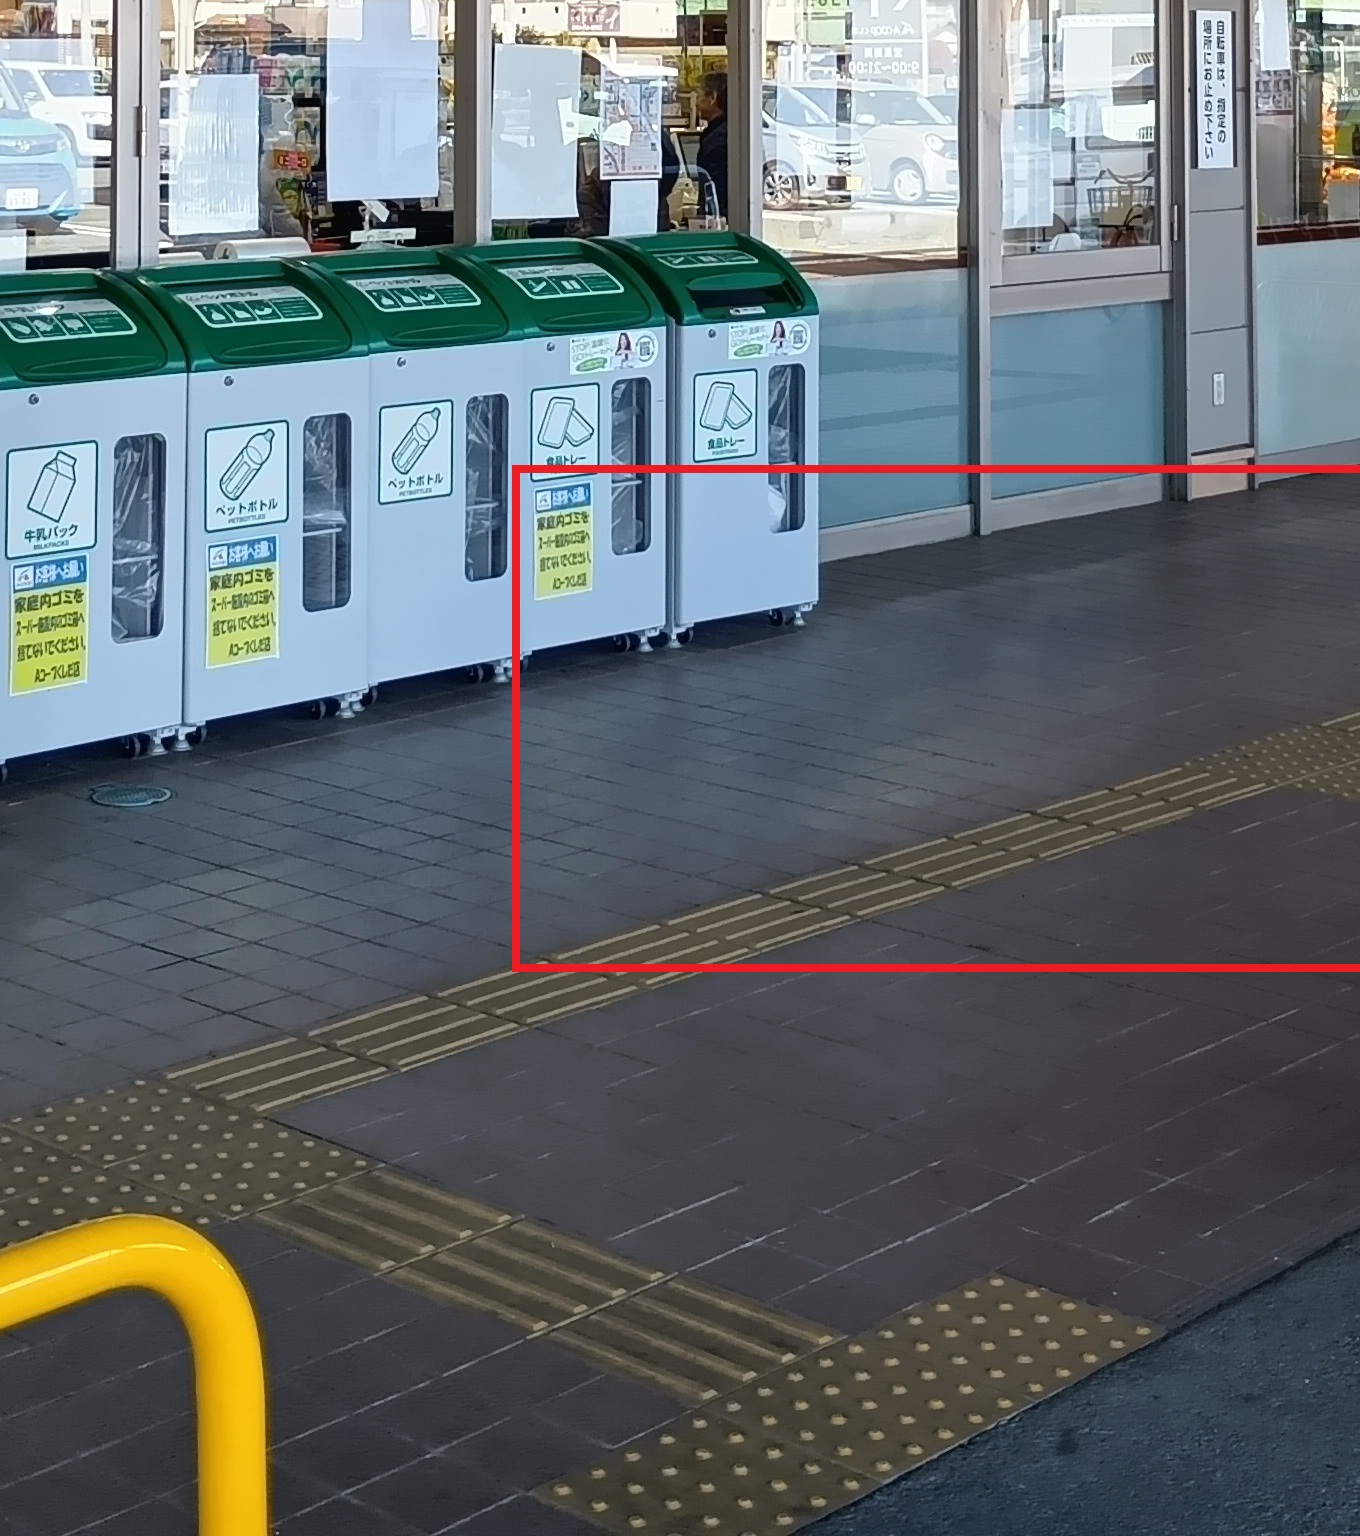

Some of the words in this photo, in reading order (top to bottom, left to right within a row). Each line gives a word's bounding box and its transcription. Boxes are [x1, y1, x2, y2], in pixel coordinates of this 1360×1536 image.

[1203, 19, 1214, 159] 場所にお止め下さい
[1216, 19, 1227, 143] 自転車は、指定の
[707, 436, 745, 450] 食品トレー
[545, 453, 587, 466] 食品トレー
[388, 472, 444, 489] ペットボトル
[216, 498, 278, 517] ペットボトル
[536, 510, 590, 531] 家庭内ゴミを
[25, 524, 78, 544] 牛乳パック
[209, 567, 275, 592] 家庭内ゴミを
[14, 588, 85, 614] 家庭内ゴミを
